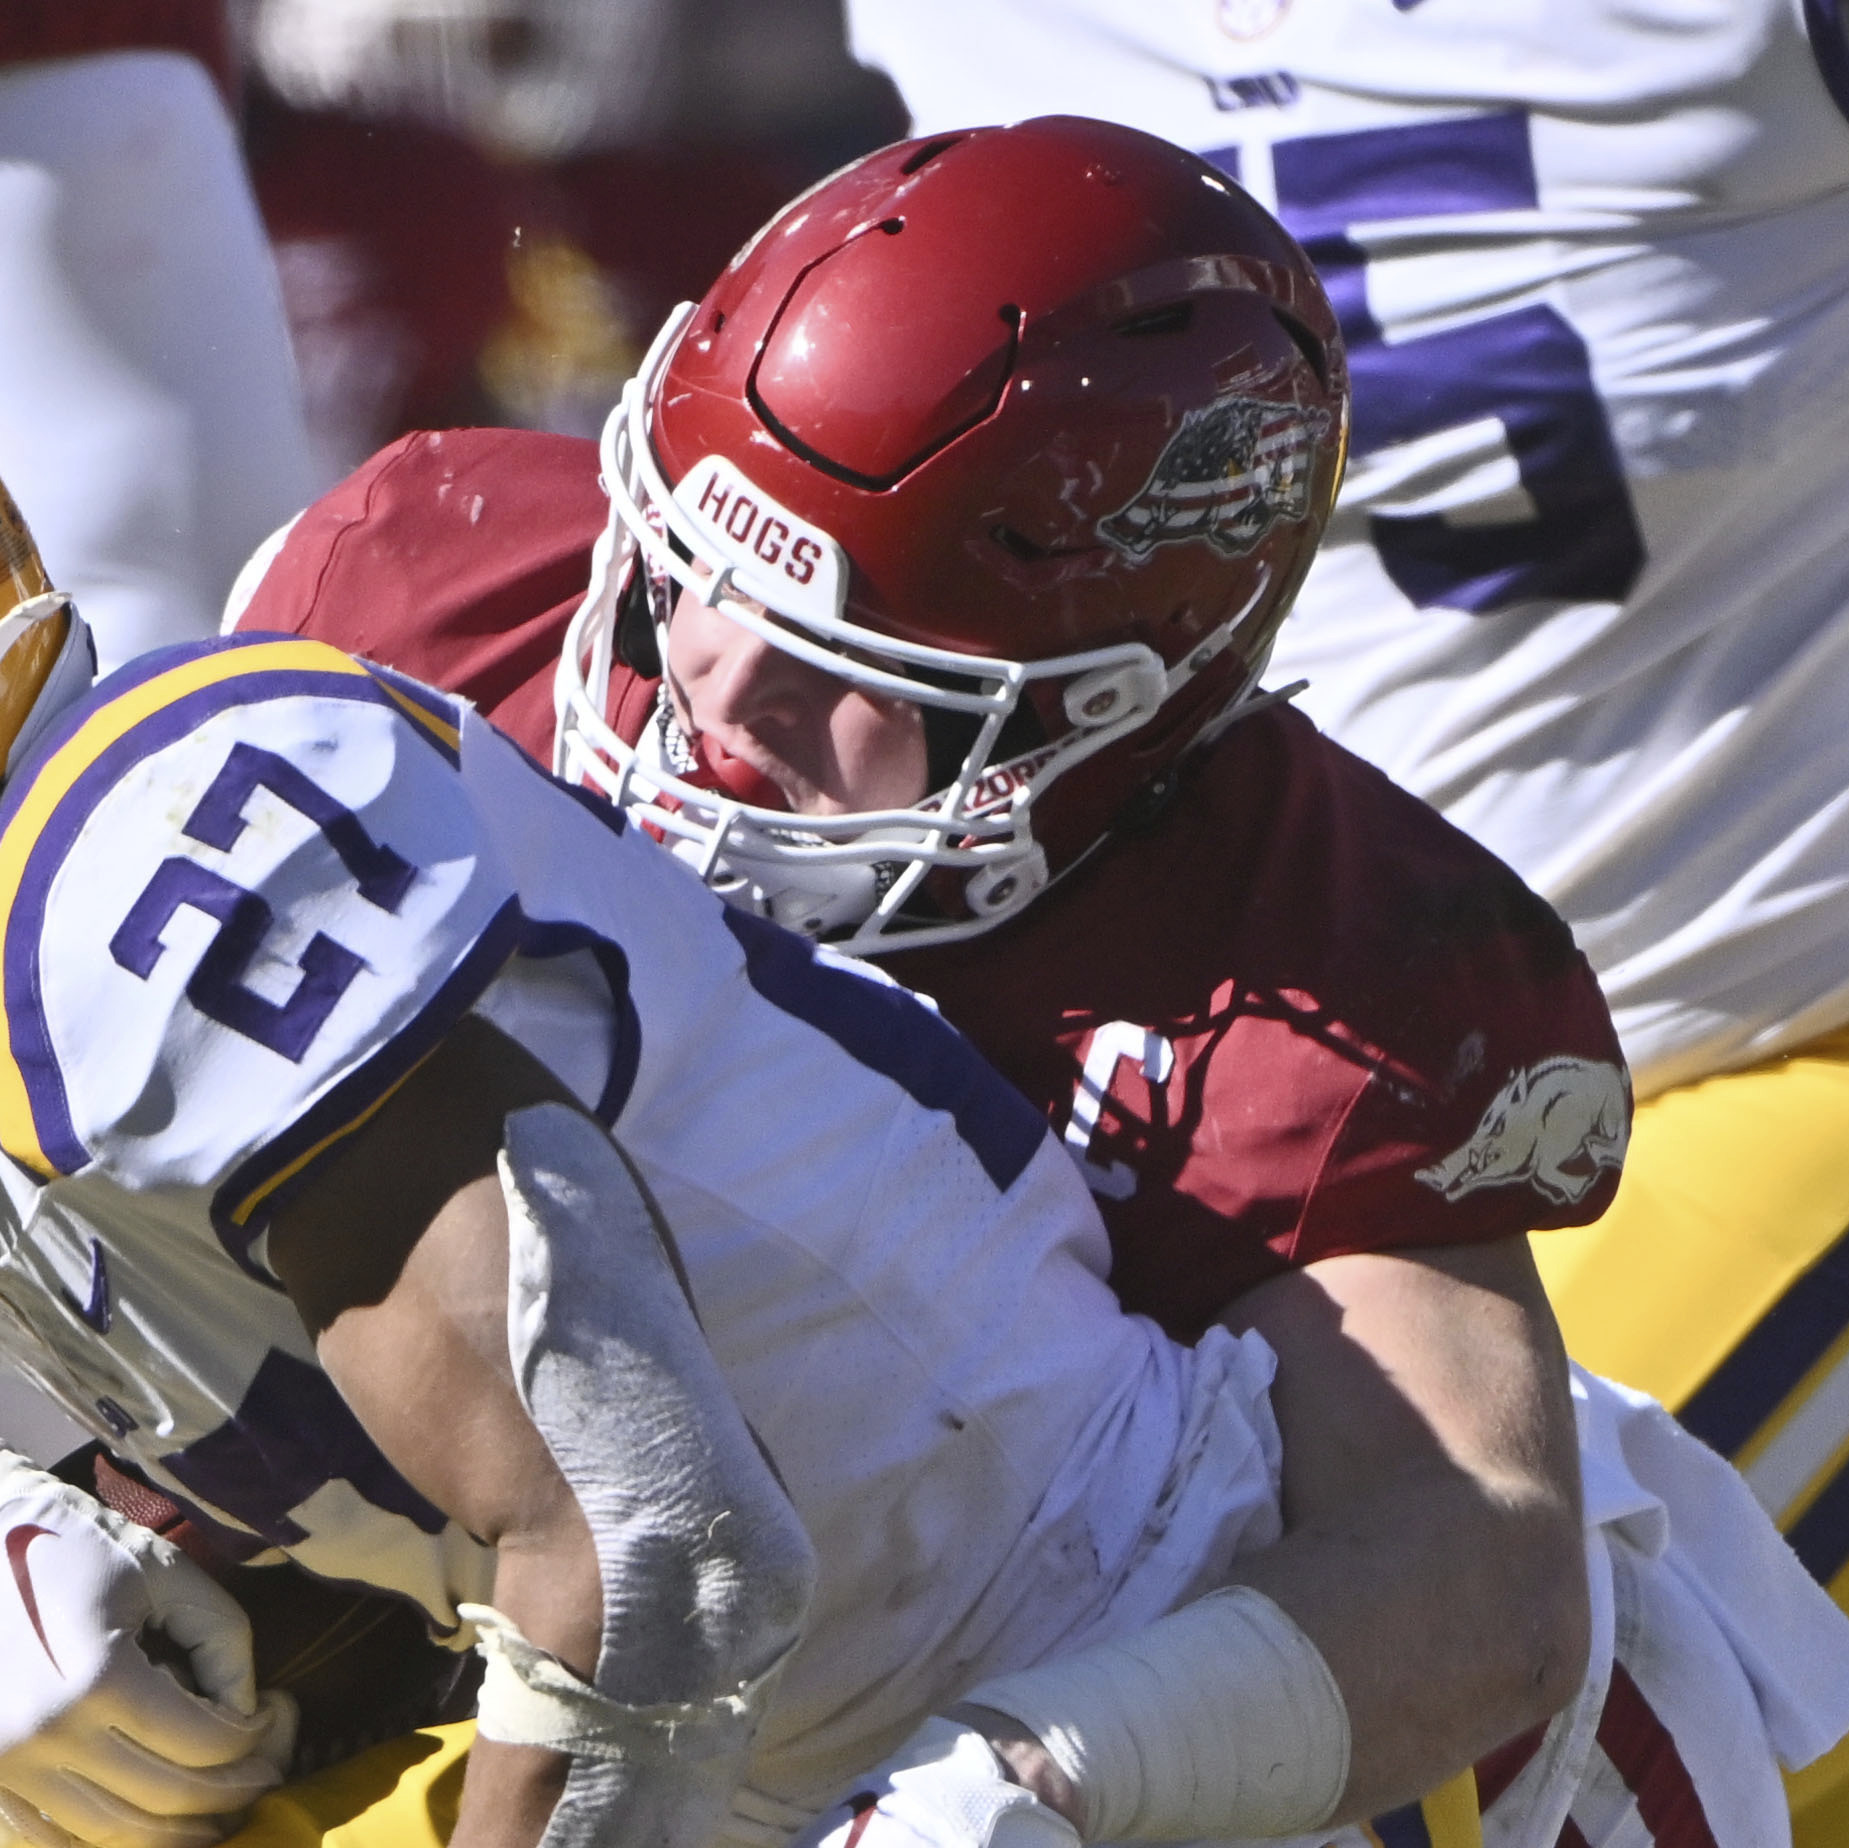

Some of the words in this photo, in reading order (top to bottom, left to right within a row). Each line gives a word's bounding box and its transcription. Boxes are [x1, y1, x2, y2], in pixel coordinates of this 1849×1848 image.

[1199, 108, 1648, 614] 5
[698, 472, 822, 585] HOGS
[108, 740, 419, 1065] 27
